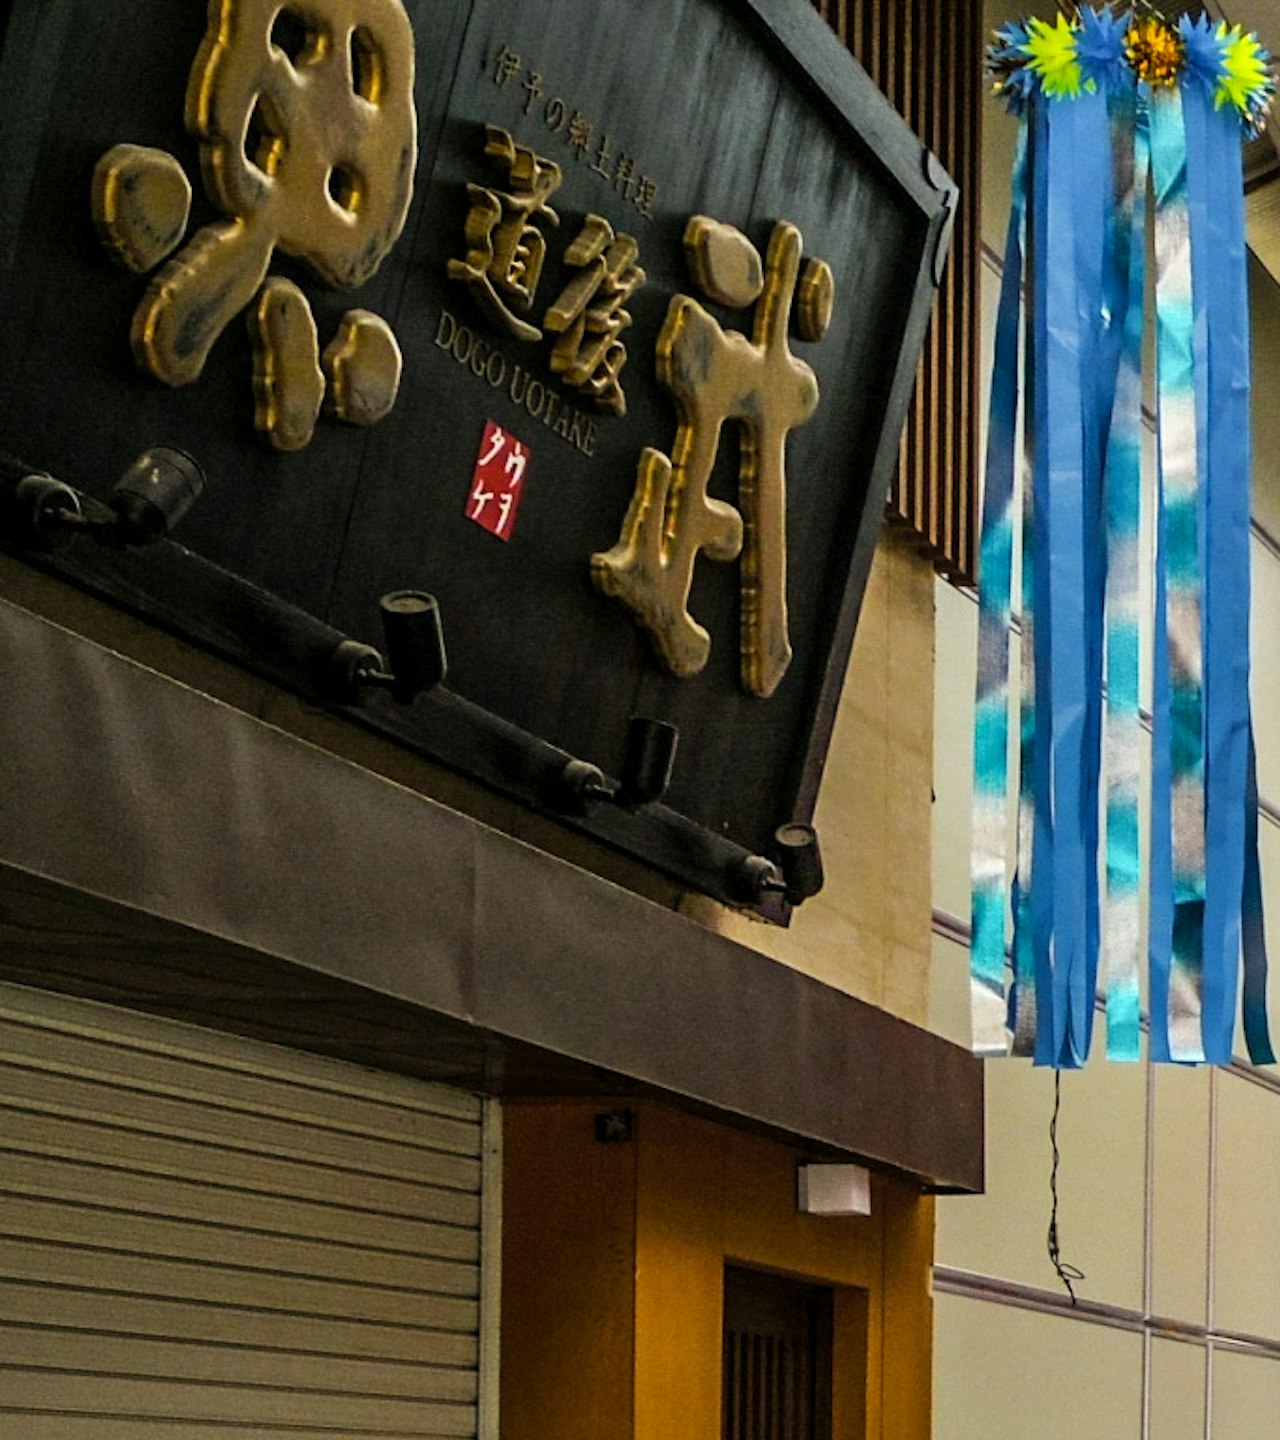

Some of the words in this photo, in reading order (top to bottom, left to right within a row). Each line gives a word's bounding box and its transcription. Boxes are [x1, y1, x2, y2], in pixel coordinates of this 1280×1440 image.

[446, 123, 647, 418] 道後
[434, 311, 504, 389] DOGO
[509, 364, 599, 459] UOTAKE
